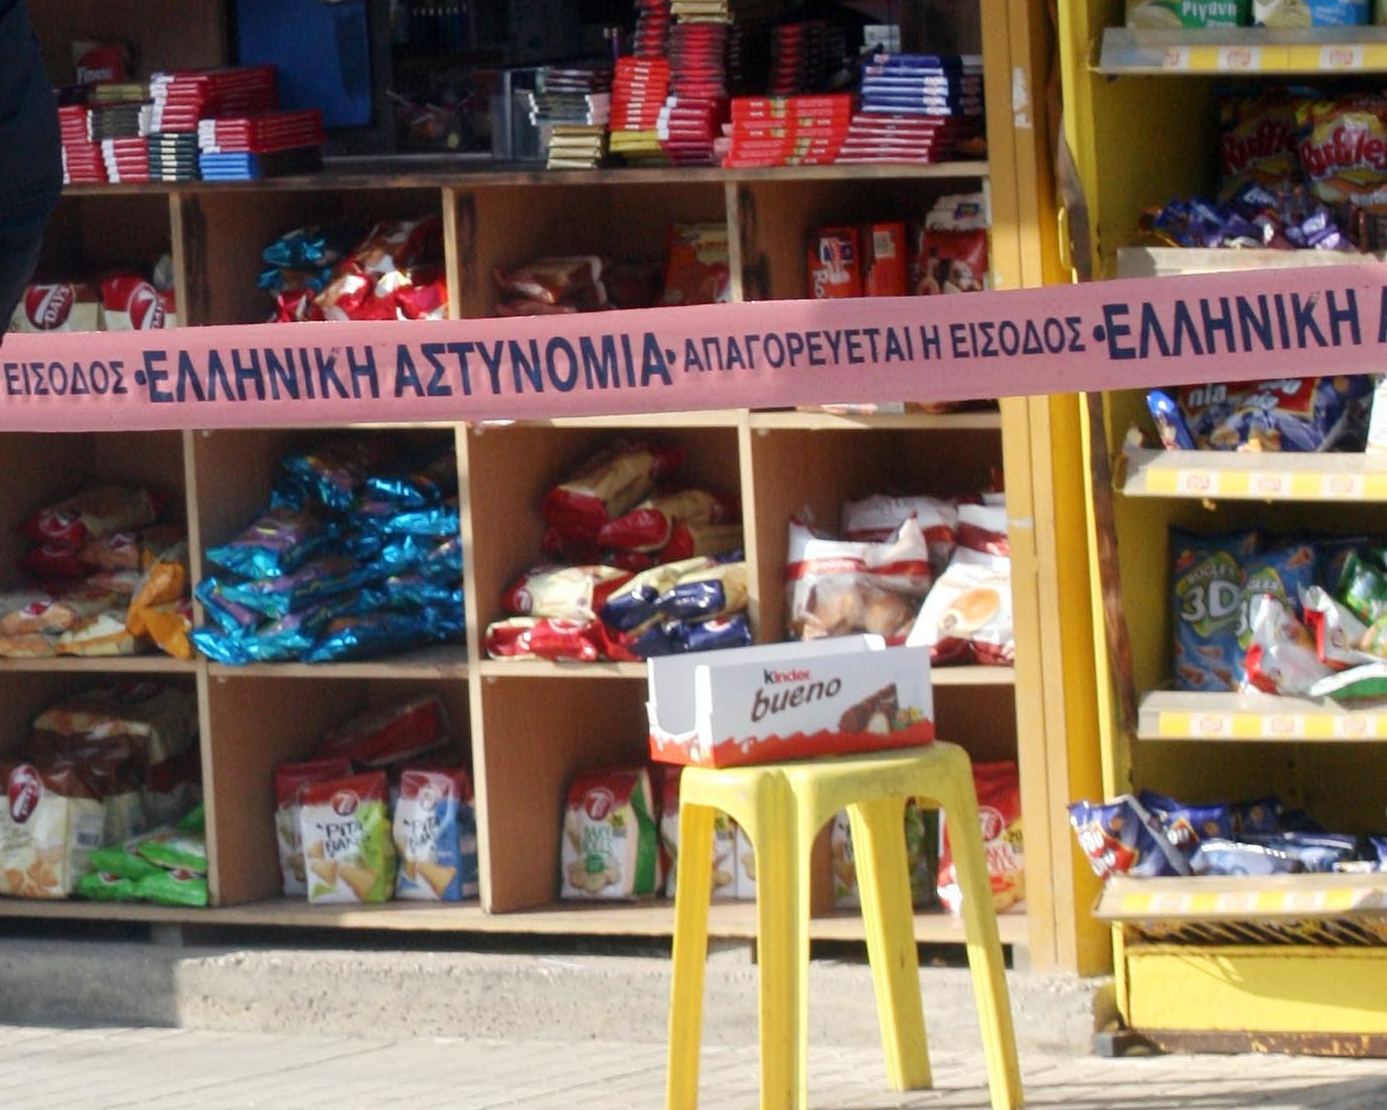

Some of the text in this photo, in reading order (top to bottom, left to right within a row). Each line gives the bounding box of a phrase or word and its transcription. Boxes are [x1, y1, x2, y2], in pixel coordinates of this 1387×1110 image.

[1299, 123, 1387, 177] Ruffle
[3, 286, 1362, 404] ΕΙΣΟΔΟΣ ΕΛΛΗΝΙΚΗ ΑΣΤΥΝΟΜΙΑ ΑΠΑΓΟΡΕΥΕΤΑΙ Η ΕΙΣΟΔΟΣ ΕΛΛΗΝΙΚΗ
[1180, 579, 1240, 622] 3D
[750, 674, 843, 724] bueno
[763, 668, 812, 686] Kinder
[325, 821, 364, 839] PITA
